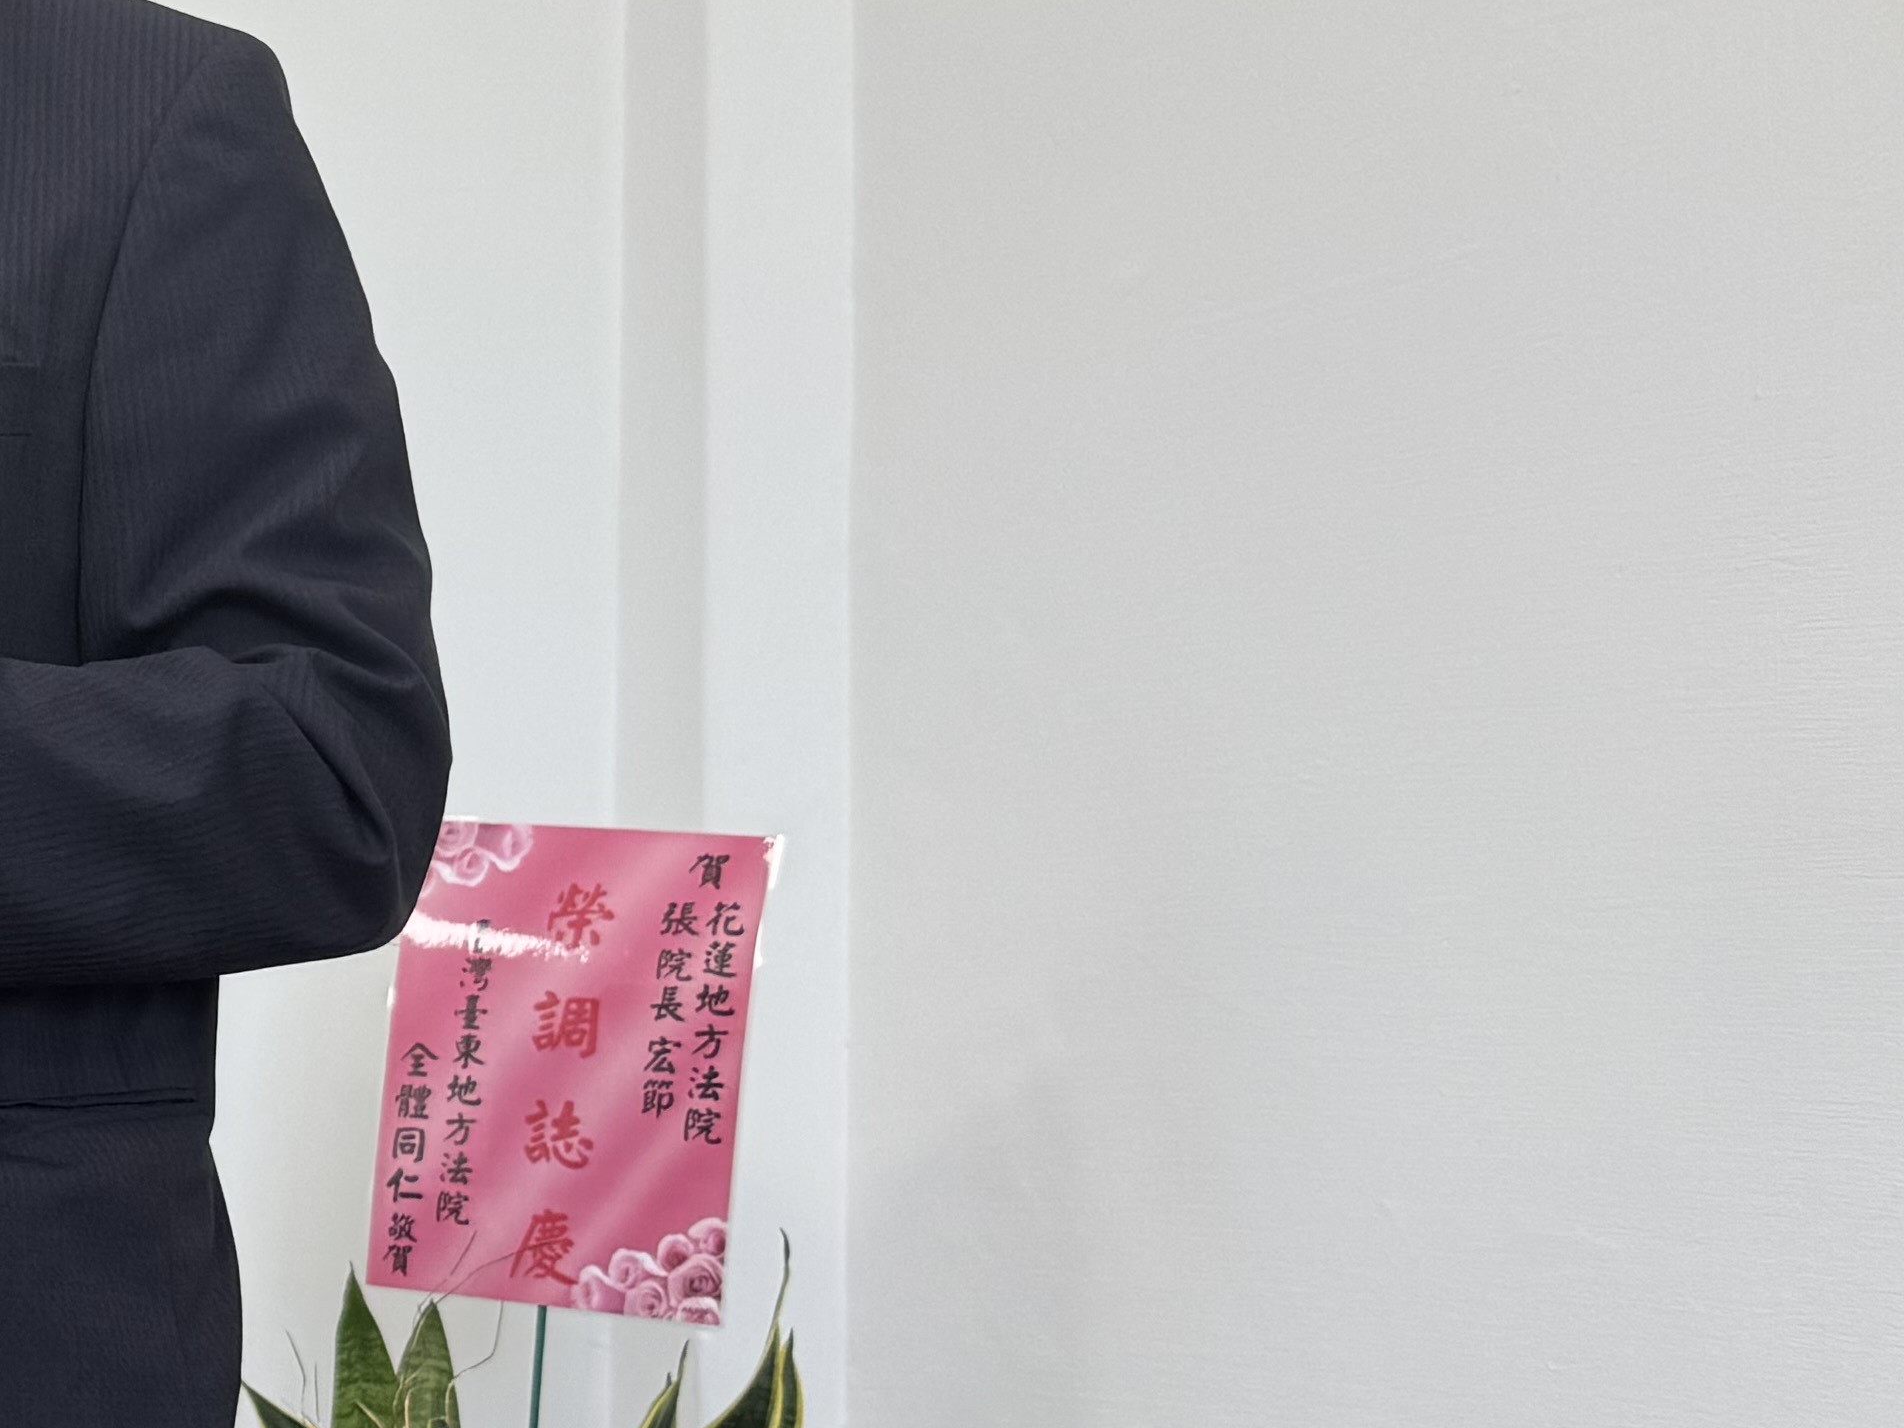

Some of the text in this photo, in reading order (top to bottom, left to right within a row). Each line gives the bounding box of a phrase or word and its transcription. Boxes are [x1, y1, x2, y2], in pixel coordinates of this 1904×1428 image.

[509, 882, 615, 1286] 榮調誌慶
[641, 901, 700, 1120] 張院長宏節
